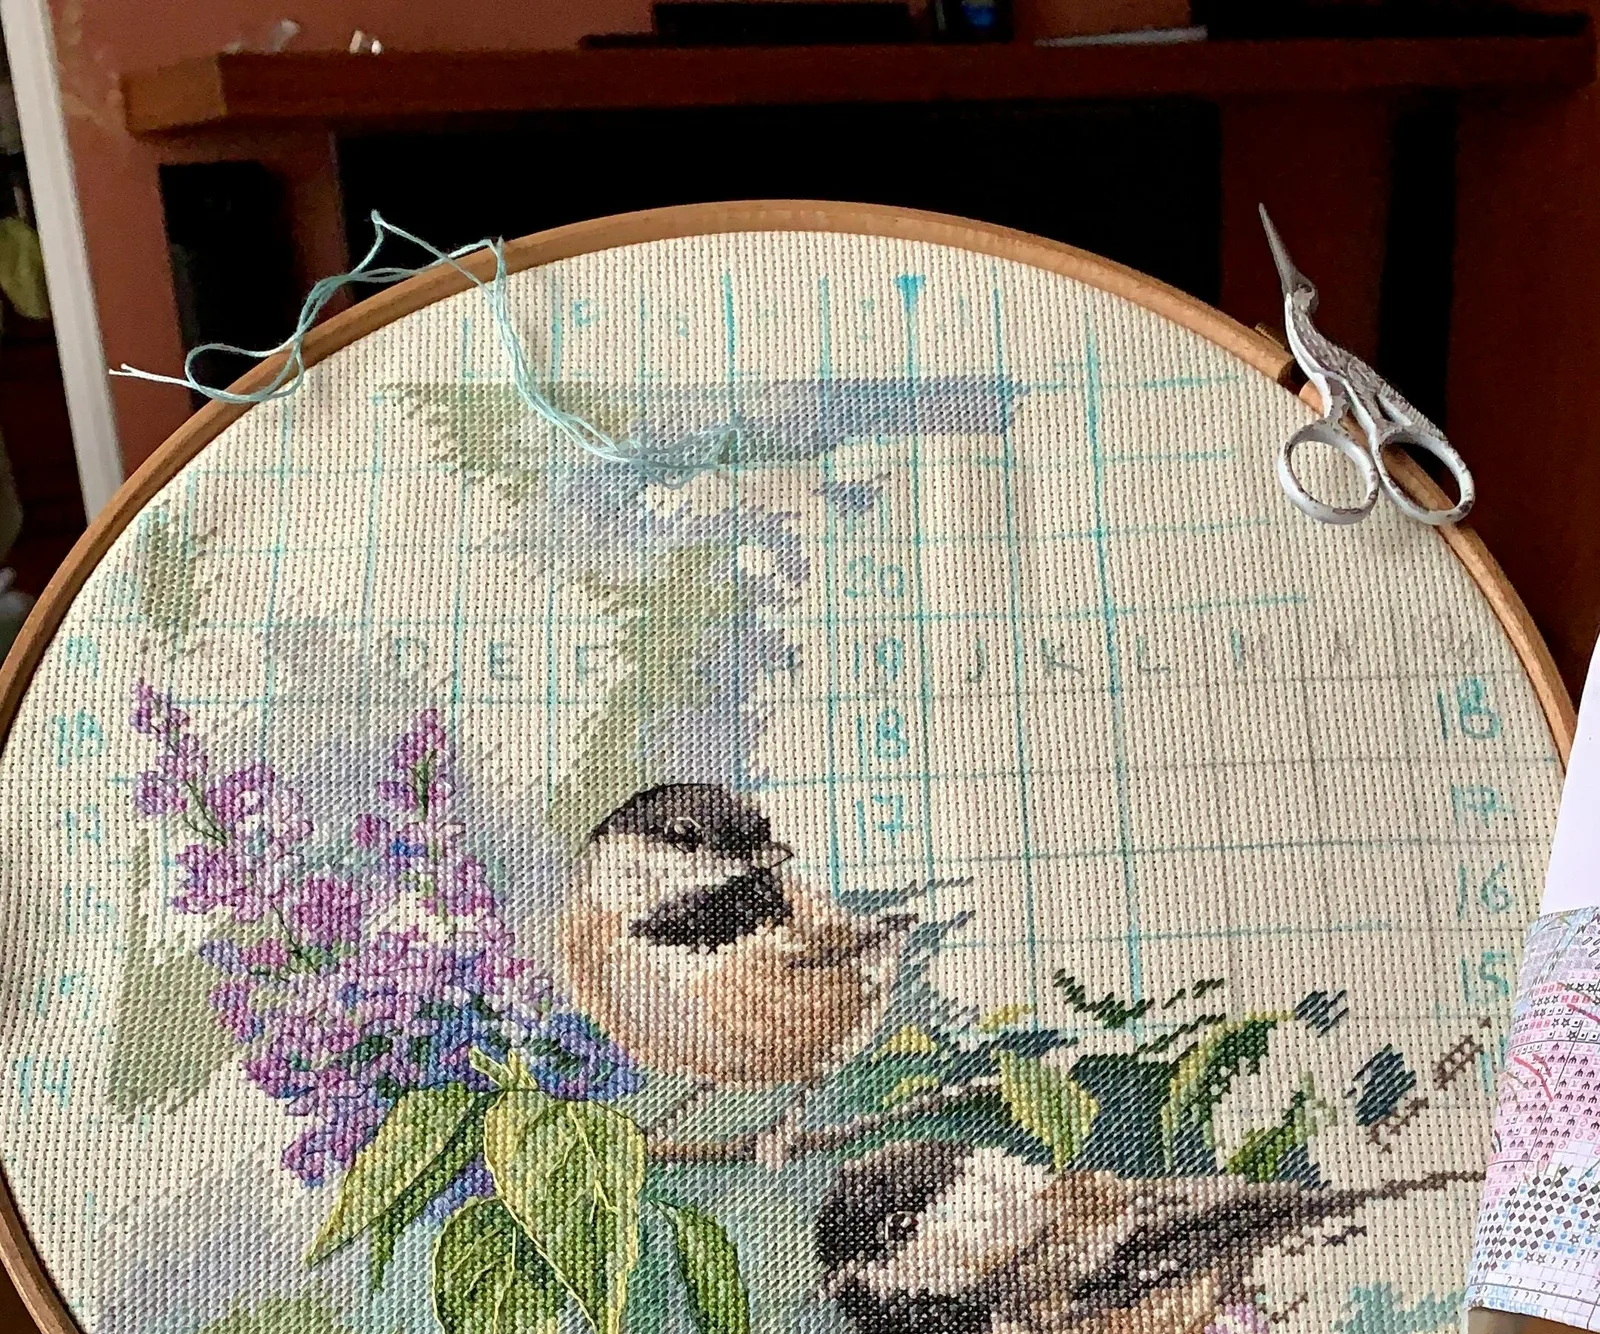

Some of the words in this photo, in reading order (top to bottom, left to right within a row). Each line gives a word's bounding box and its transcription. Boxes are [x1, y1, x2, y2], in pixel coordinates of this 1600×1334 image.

[487, 640, 522, 682] E
[575, 644, 608, 685] F
[964, 638, 986, 683] J
[1040, 635, 1085, 677] K
[852, 637, 903, 681] 19
[1435, 674, 1501, 740] 18
[855, 707, 908, 778] 18
[855, 793, 912, 860] 17
[1456, 860, 1513, 921] 16
[1460, 952, 1513, 1003] 15
